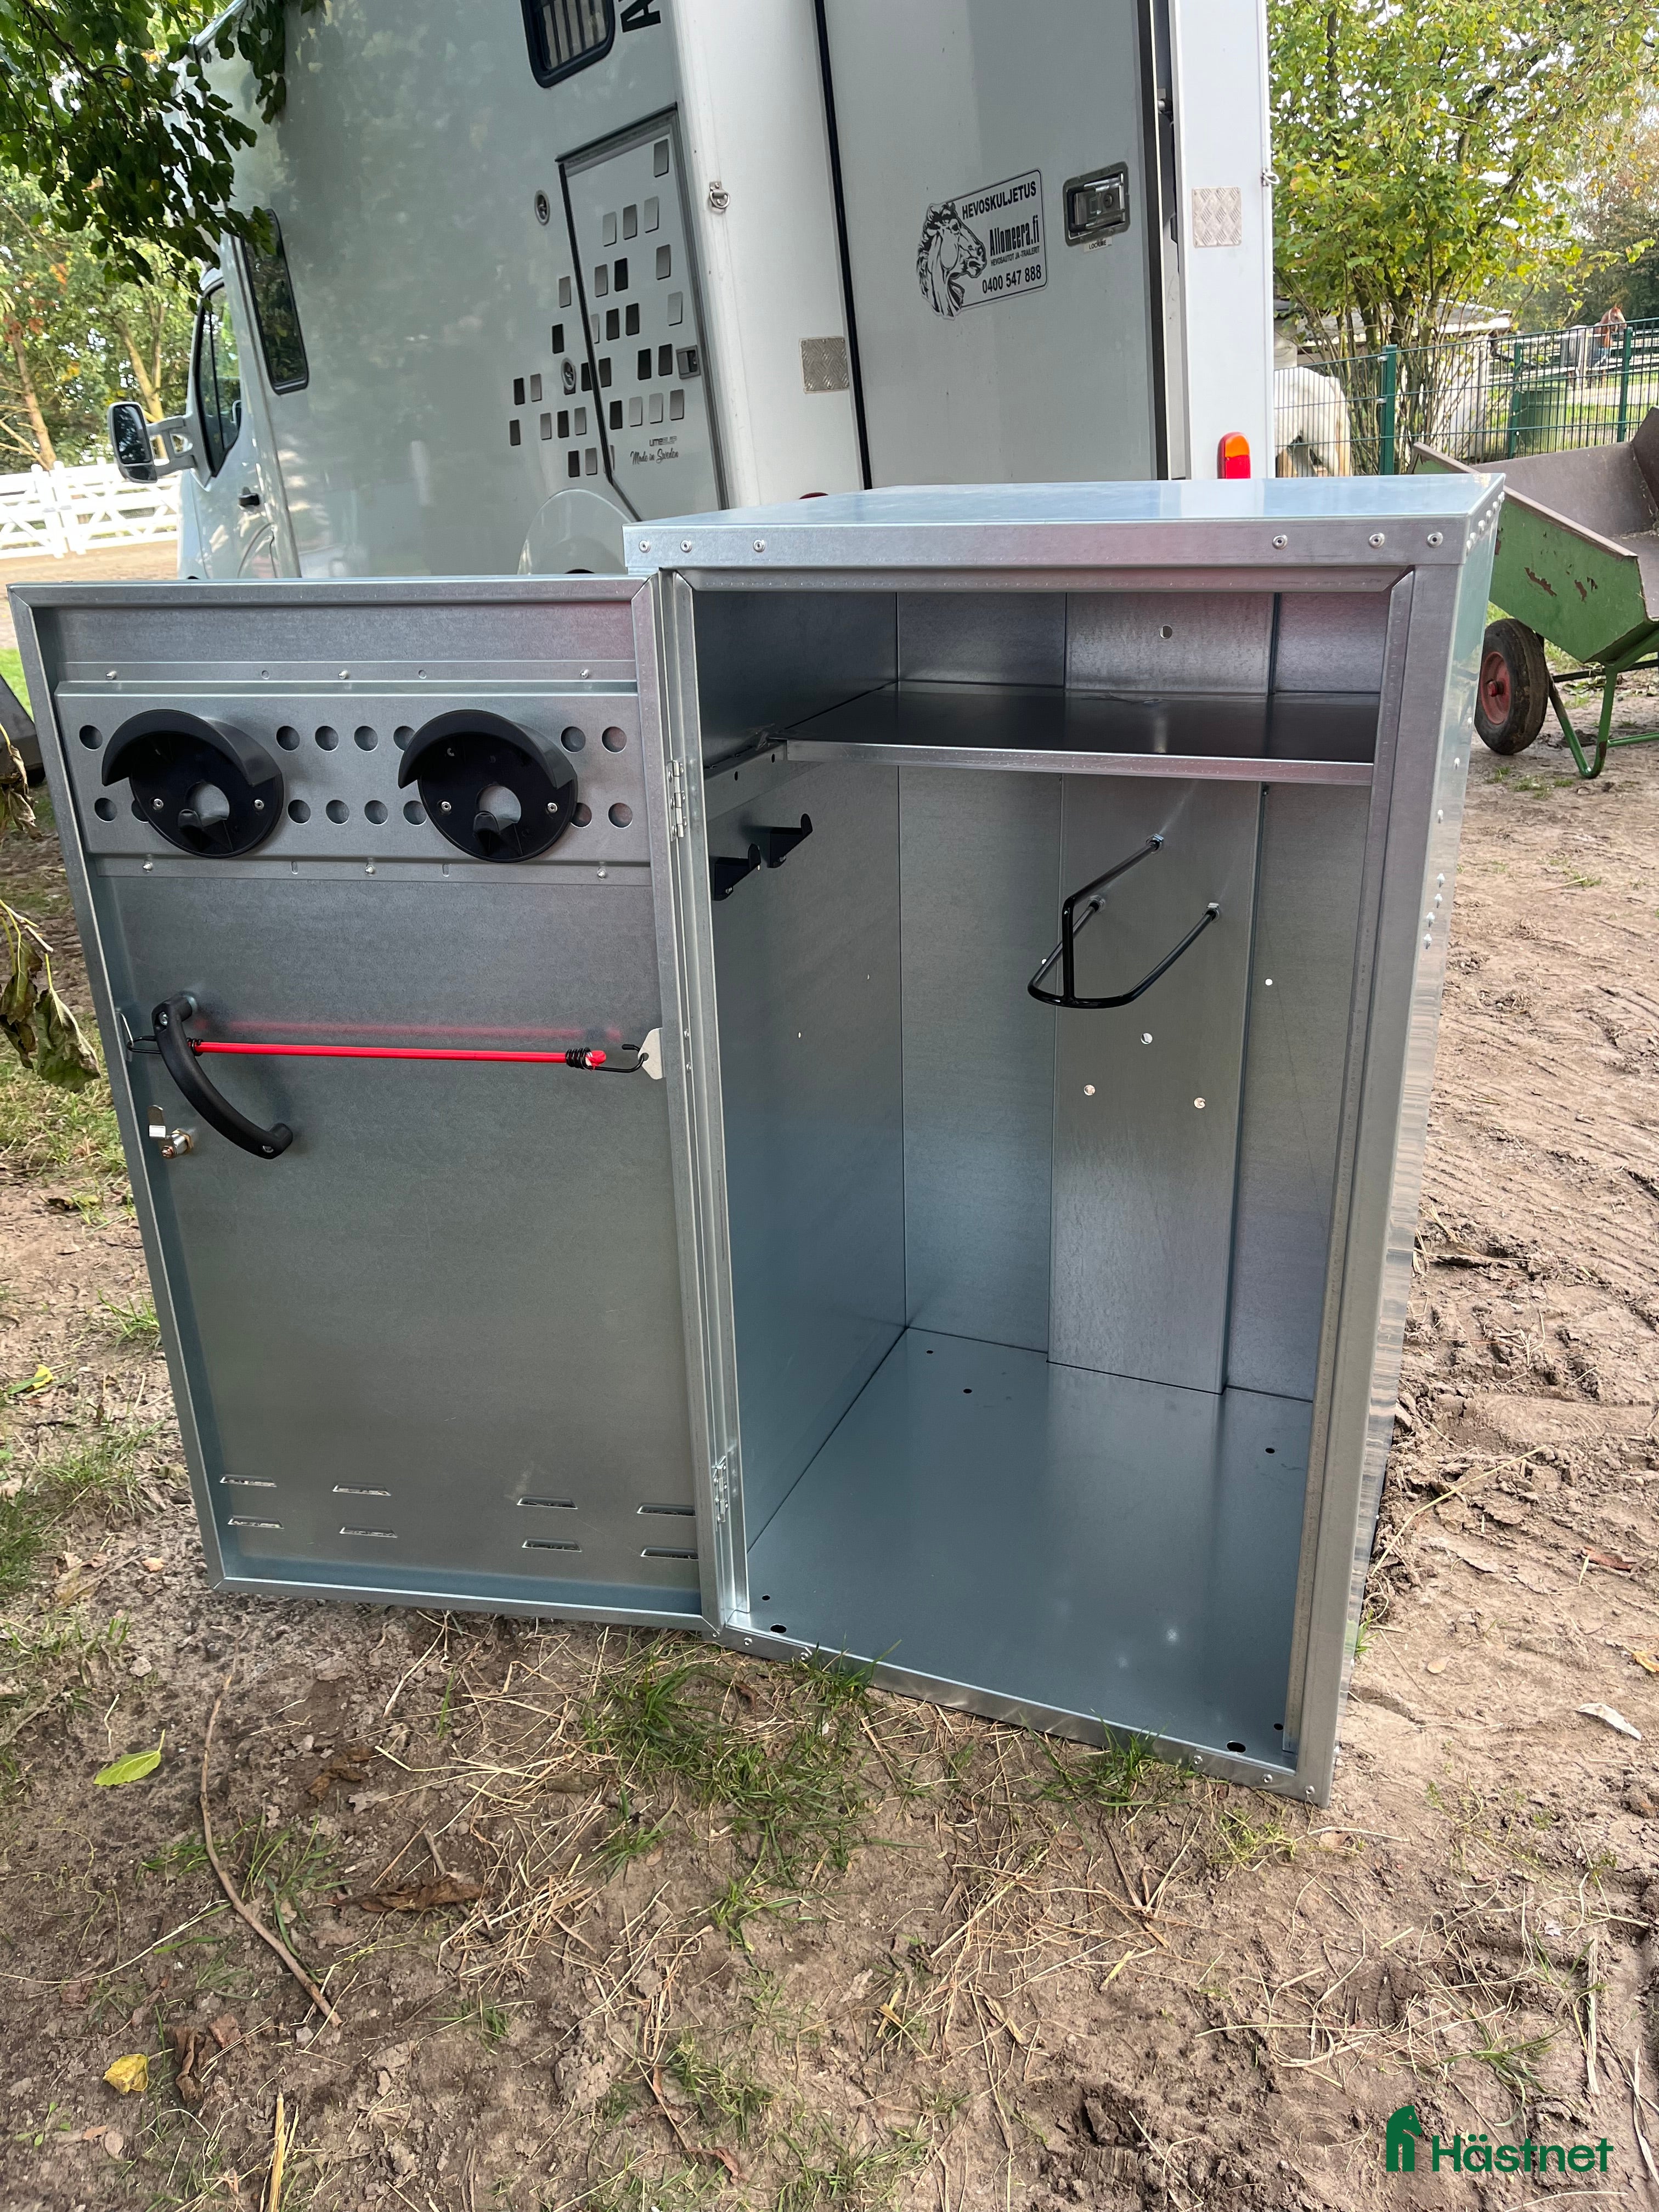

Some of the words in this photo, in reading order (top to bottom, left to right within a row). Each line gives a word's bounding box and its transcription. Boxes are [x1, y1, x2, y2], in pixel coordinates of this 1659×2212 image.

[962, 181, 1036, 220] HEVOSKULJETUS
[990, 215, 1039, 256] Allomeera.fi
[991, 253, 1014, 266] HEVOSAUTOT
[983, 275, 1003, 294] 0400
[1006, 269, 1022, 287] 547
[1025, 264, 1041, 283] 888
[630, 451, 647, 465] Made
[656, 447, 679, 464] Sweden
